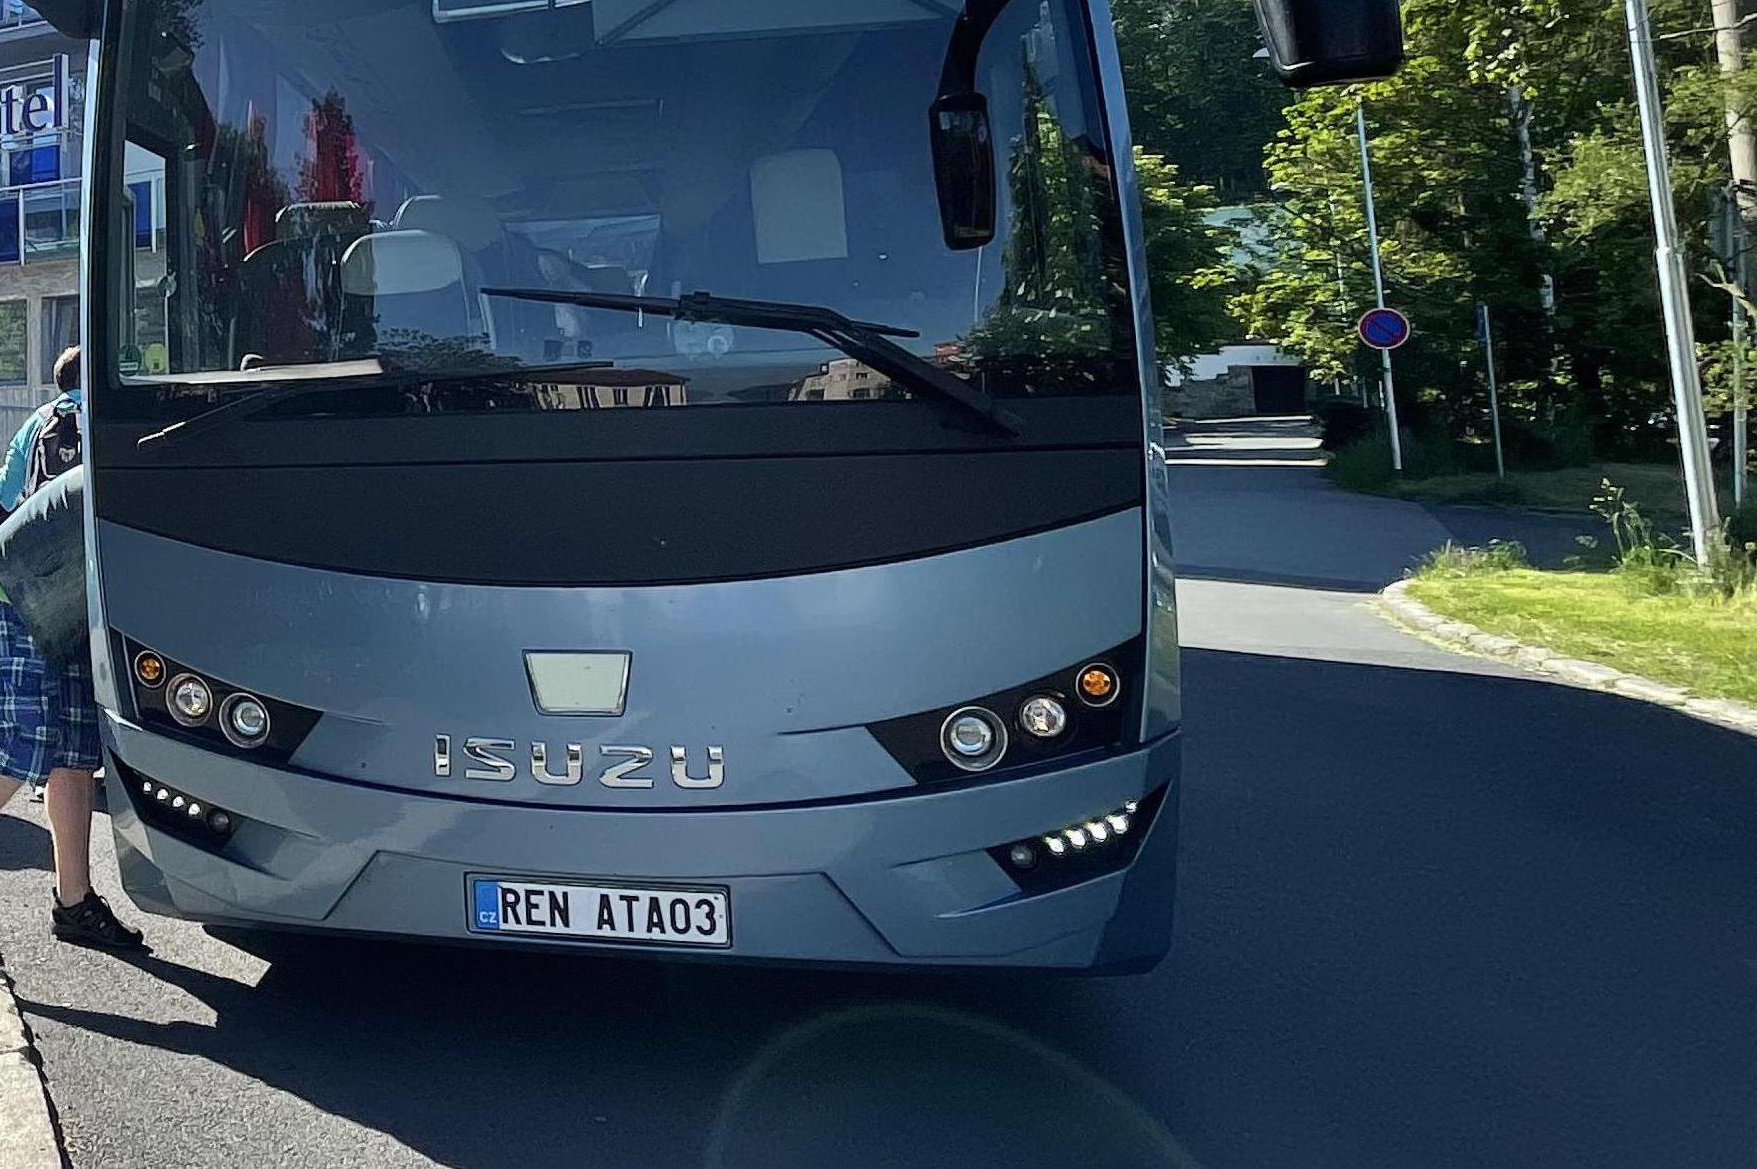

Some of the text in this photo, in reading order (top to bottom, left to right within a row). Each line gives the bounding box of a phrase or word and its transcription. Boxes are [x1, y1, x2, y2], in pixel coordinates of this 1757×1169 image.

[435, 734, 725, 789] ISUZU
[479, 910, 498, 924] CZ
[501, 887, 717, 936] REN ATA03
